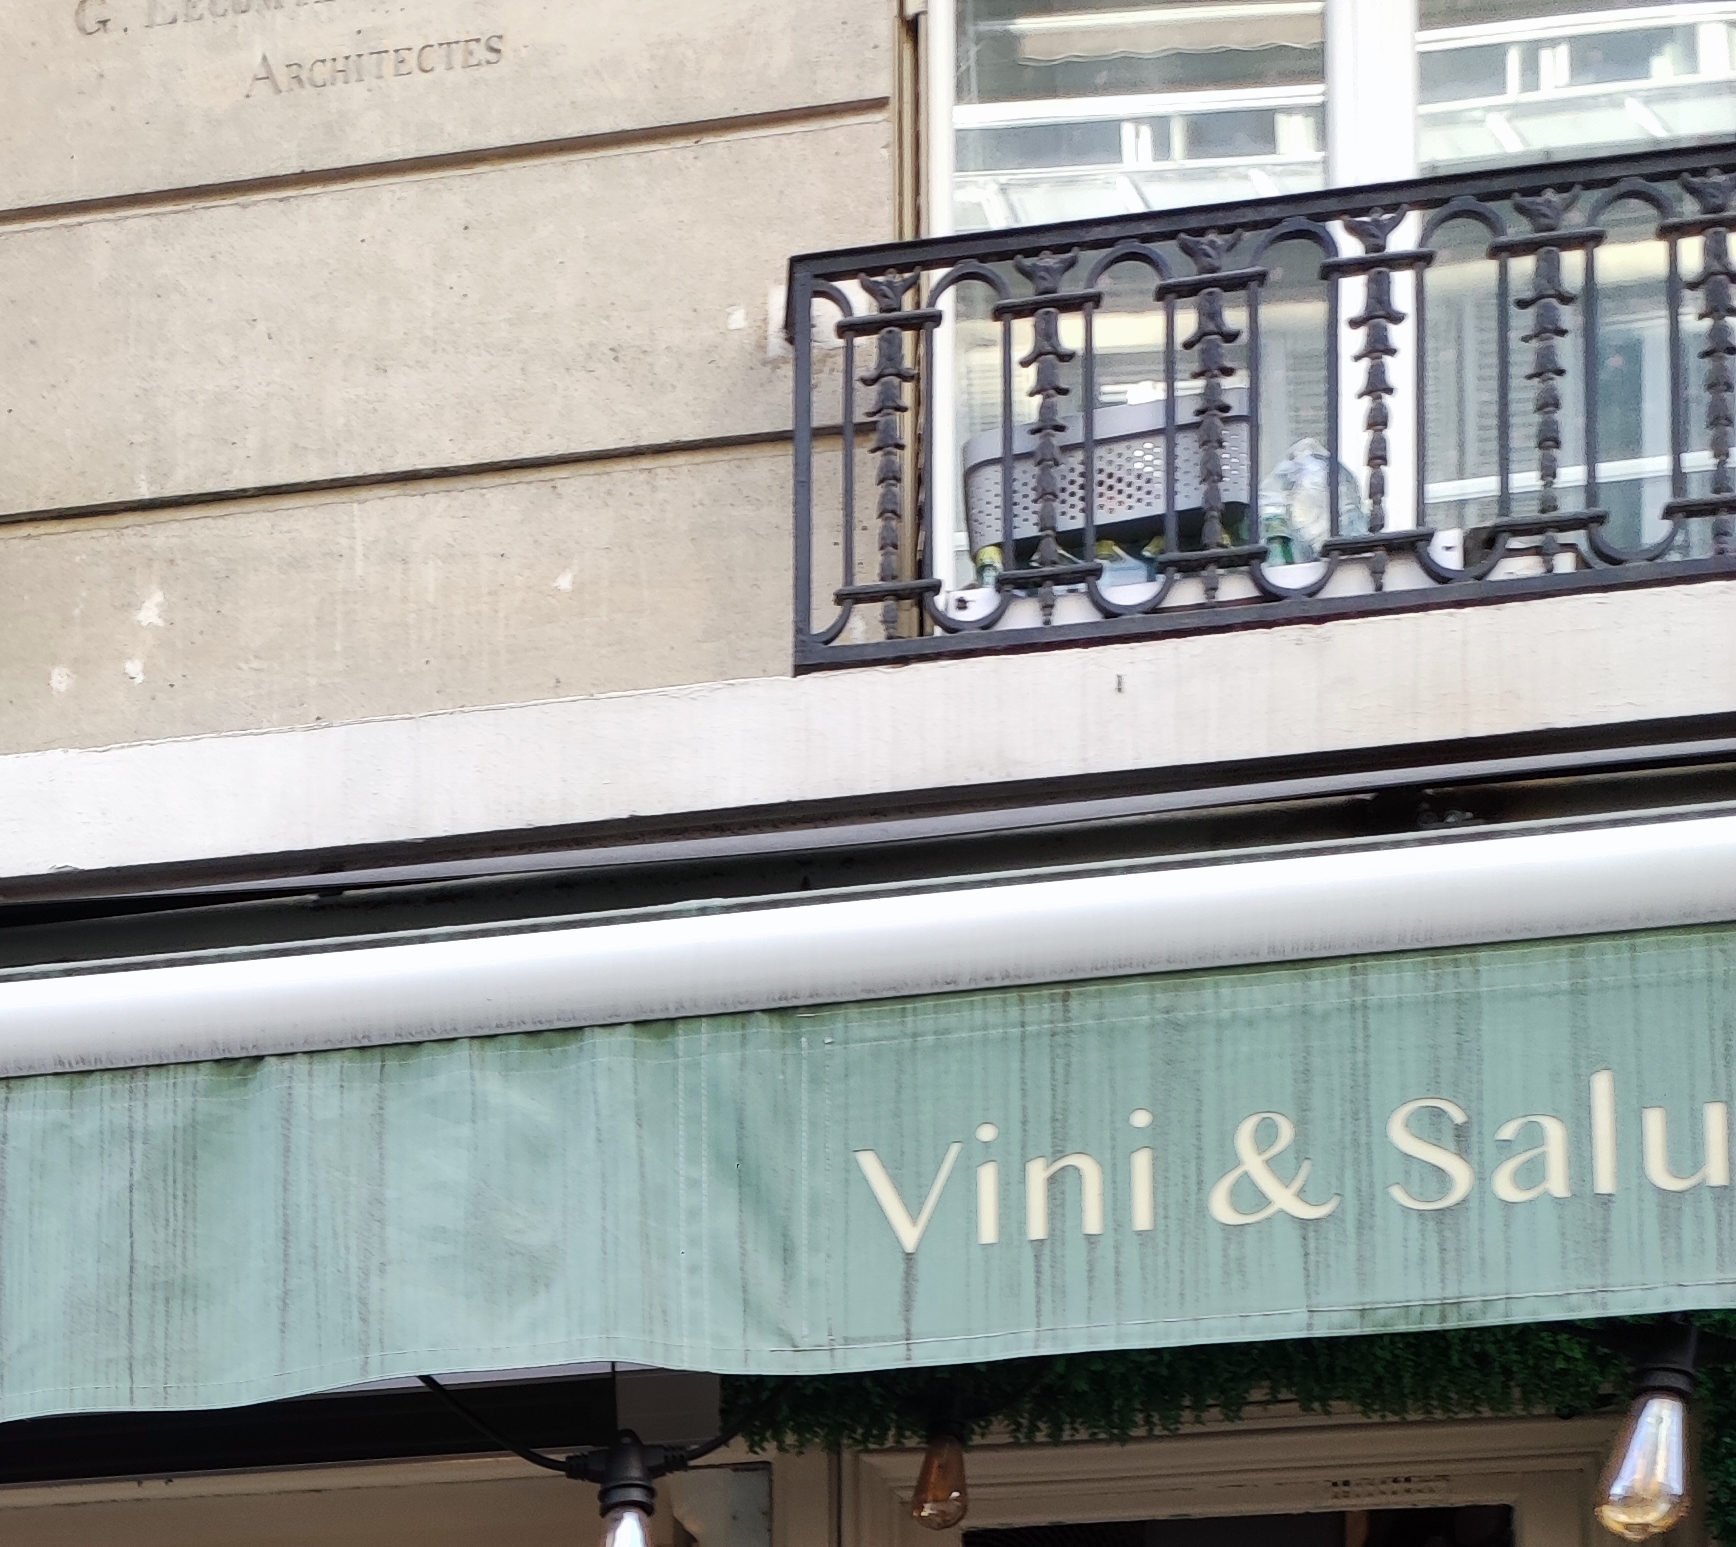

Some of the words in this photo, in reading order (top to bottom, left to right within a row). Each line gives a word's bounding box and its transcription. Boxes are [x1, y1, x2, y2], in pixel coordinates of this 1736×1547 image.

[854, 1108, 1155, 1254] Vini
[1208, 1111, 1342, 1226] &
[1386, 1069, 1730, 1211] Salu
